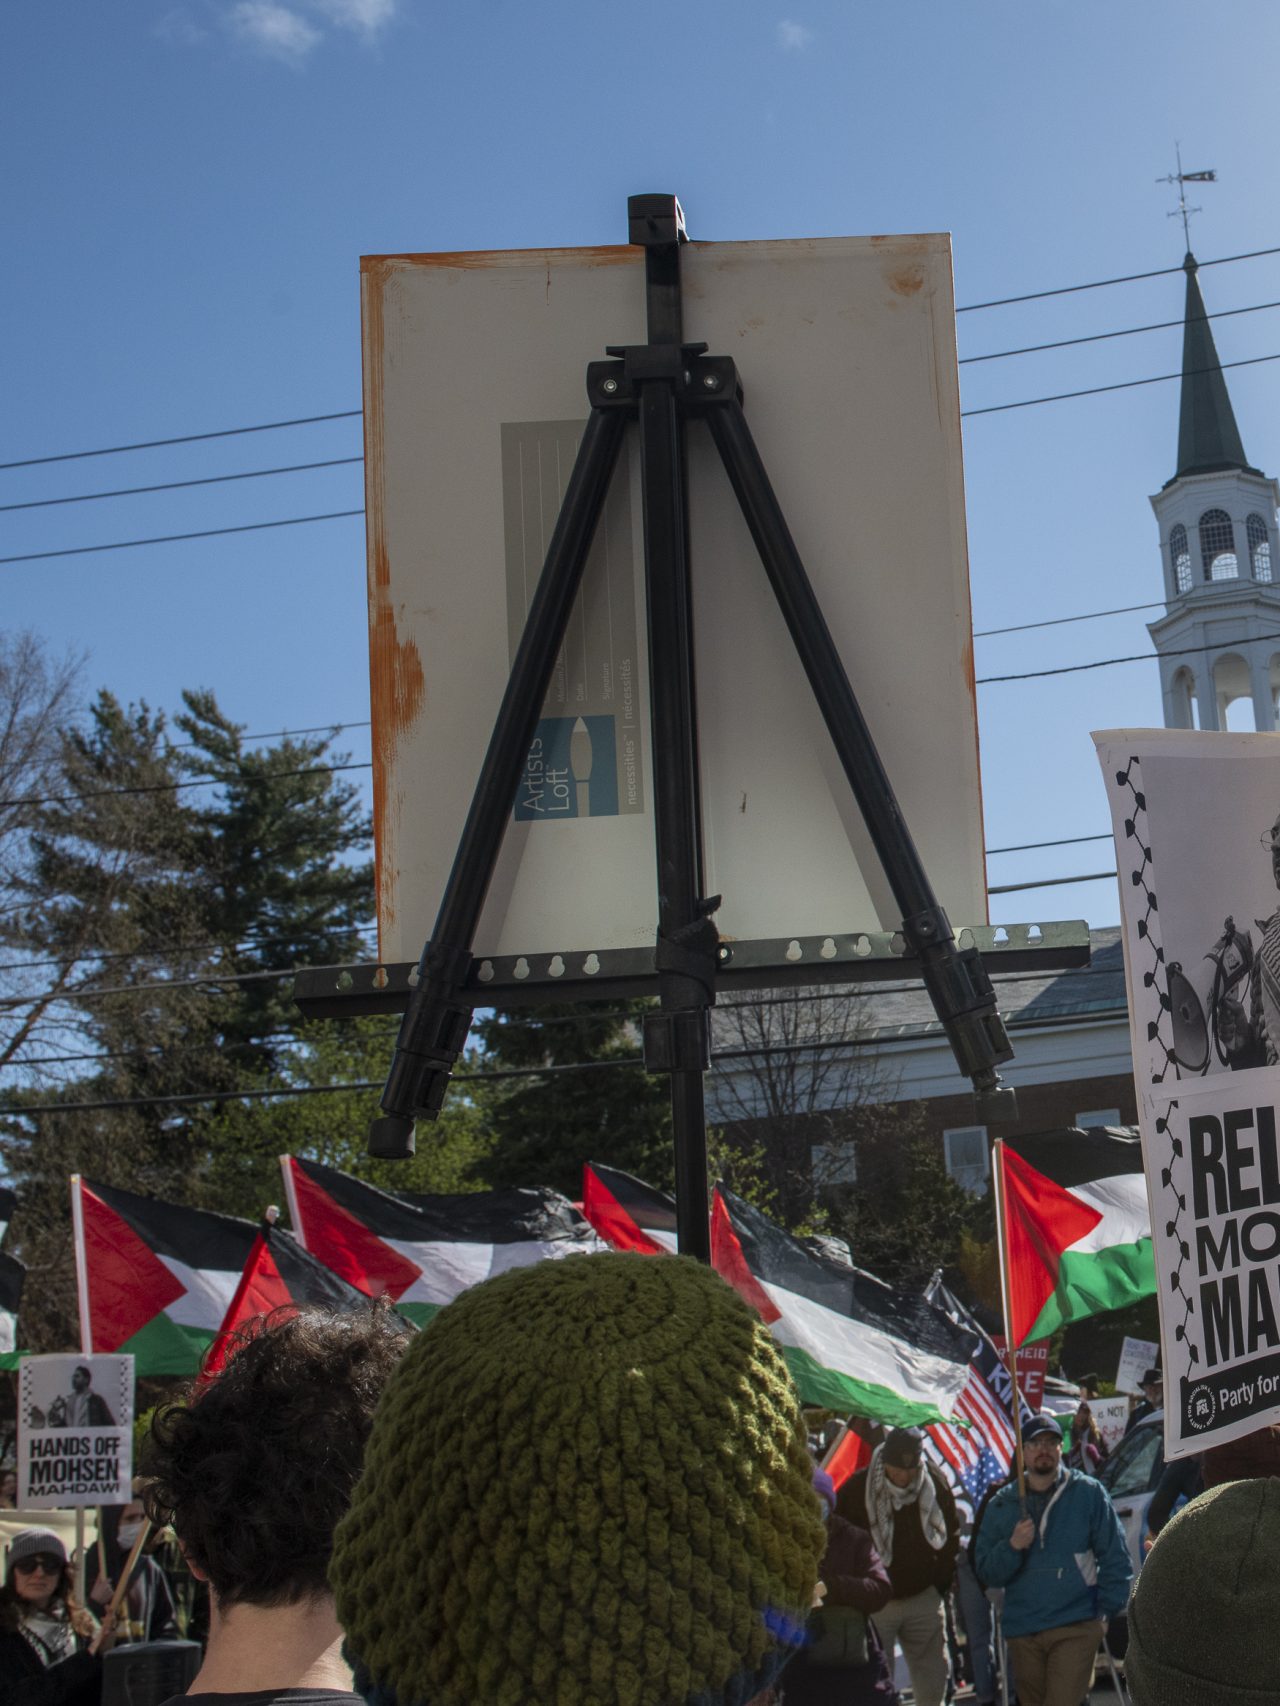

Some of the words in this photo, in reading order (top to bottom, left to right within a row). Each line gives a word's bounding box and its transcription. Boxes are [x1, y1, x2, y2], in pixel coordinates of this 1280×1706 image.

[522, 737, 545, 812] Artists
[546, 767, 570, 811] Loft
[1219, 1382, 1254, 1411] Party
[1257, 1375, 1280, 1396] for
[1107, 1405, 1125, 1417] NOT
[1196, 1402, 1210, 1417] PSL
[30, 1436, 90, 1458] HANDS
[95, 1436, 120, 1456] OFF
[30, 1458, 119, 1485] MOHSEN
[28, 1482, 120, 1497] MAHDAWI
